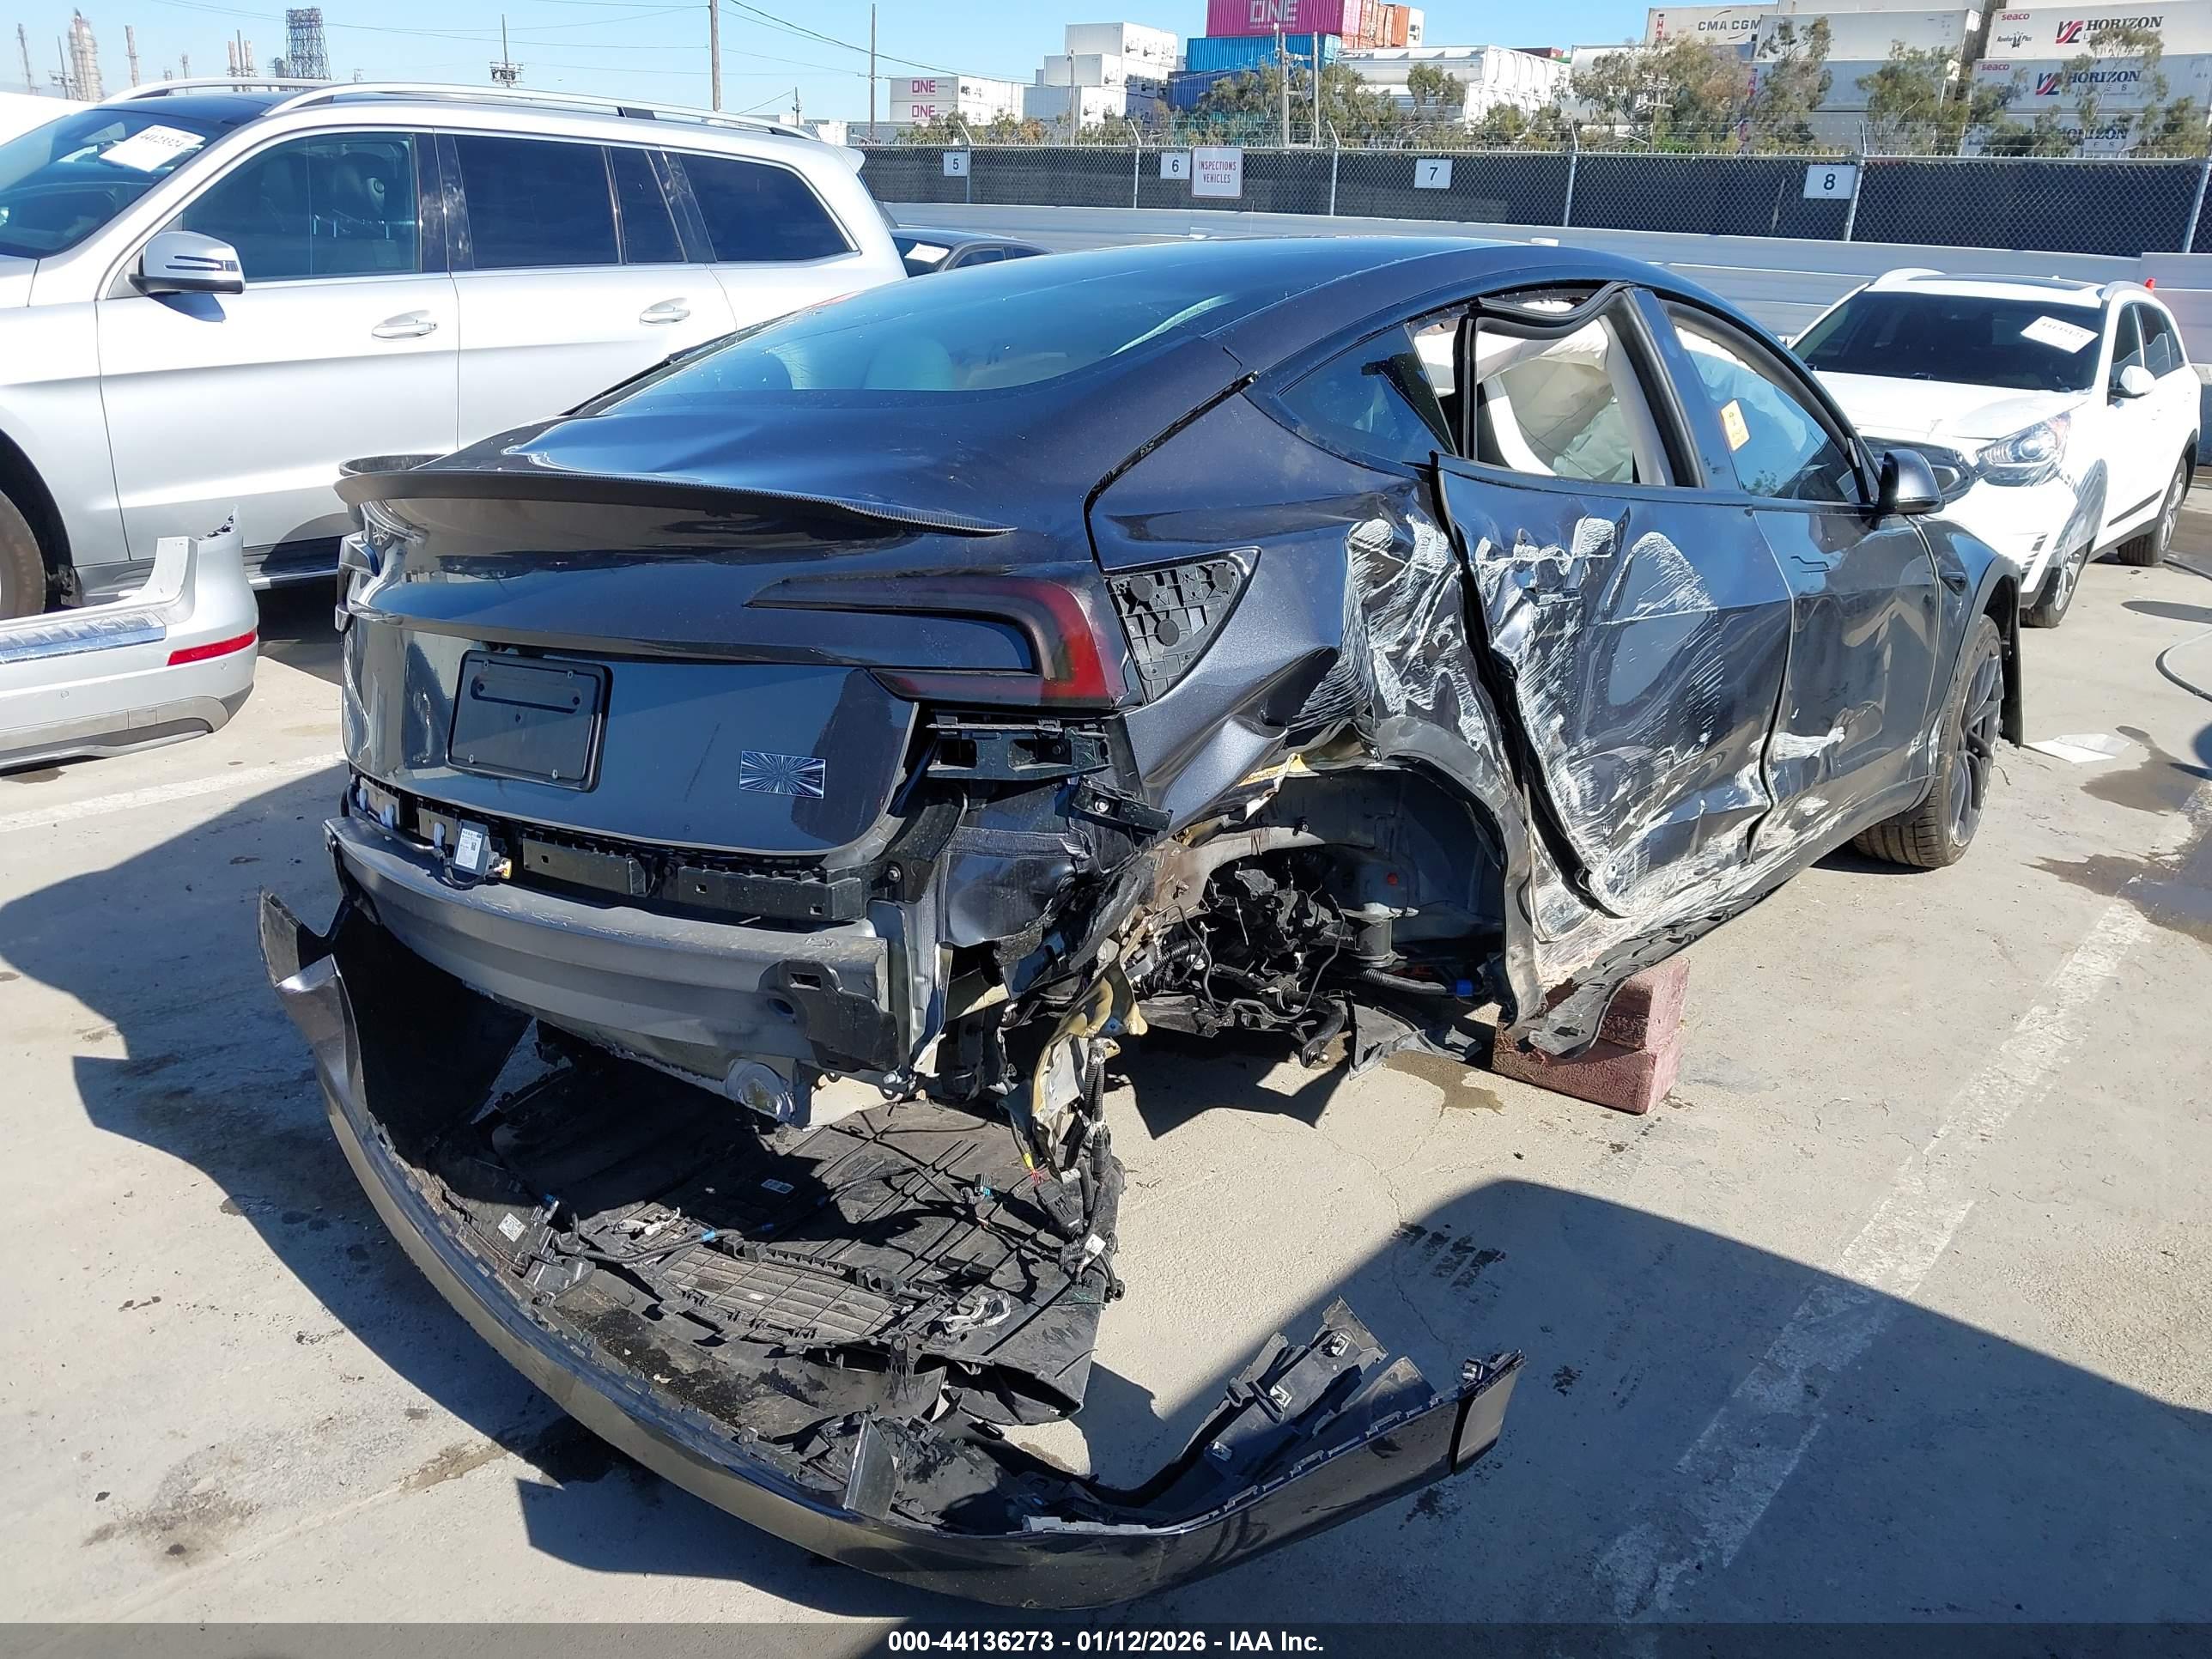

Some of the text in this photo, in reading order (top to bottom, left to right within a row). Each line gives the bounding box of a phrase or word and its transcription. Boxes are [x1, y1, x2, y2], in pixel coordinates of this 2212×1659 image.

[1250, 0, 1297, 22] ONE
[1698, 20, 1760, 31] CMA CGM
[2086, 16, 2164, 31] HORIZON
[2069, 70, 2142, 83] HORIZON
[912, 80, 936, 94] ONE
[912, 105, 935, 118] ONE
[2066, 128, 2127, 140] OIZON
[953, 158, 959, 170] 5
[1171, 159, 1180, 173] 6
[1198, 161, 1237, 171] INSPECTIONS
[1202, 173, 1231, 184] VEHICLES
[1429, 167, 1438, 181] 7
[1823, 173, 1836, 190] 8
